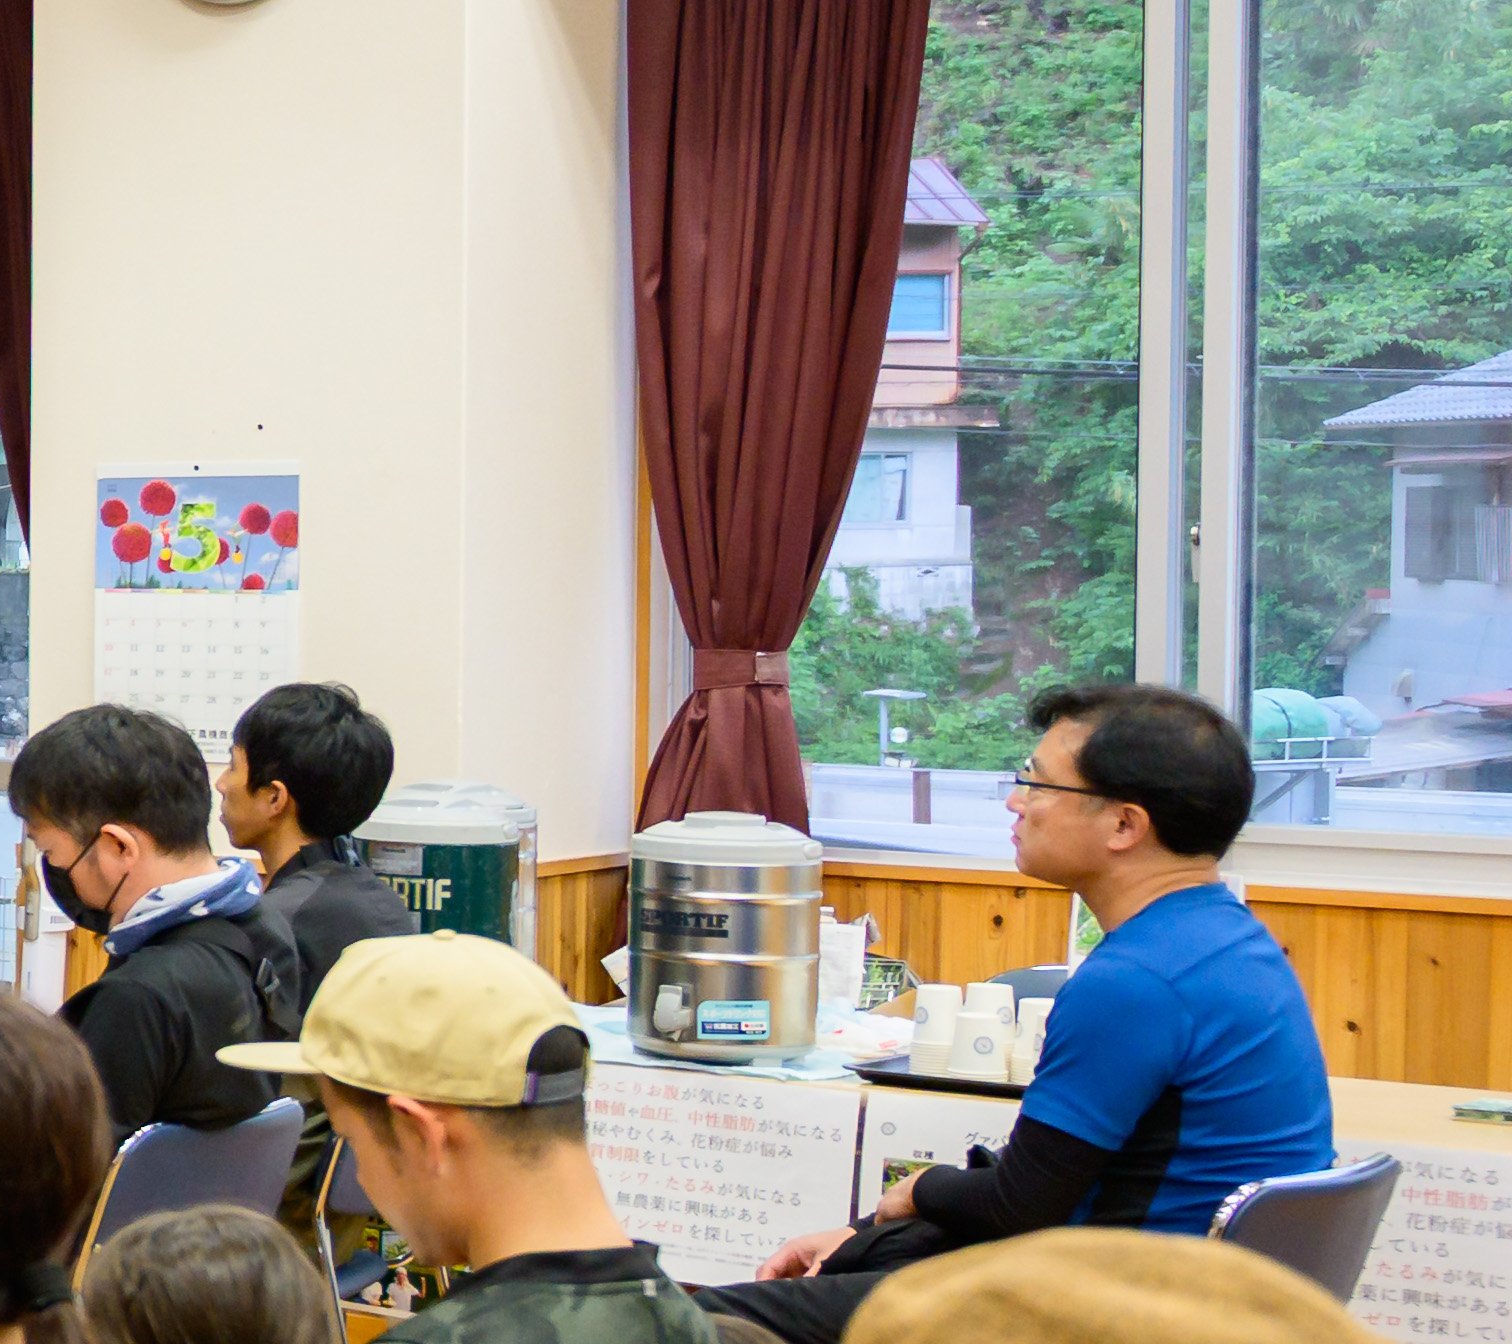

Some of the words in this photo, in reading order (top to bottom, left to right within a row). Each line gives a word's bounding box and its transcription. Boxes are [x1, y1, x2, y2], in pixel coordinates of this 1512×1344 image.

[170, 503, 220, 574] 5
[378, 877, 451, 911] RTIF
[590, 1143, 724, 1173] 質制限をしている
